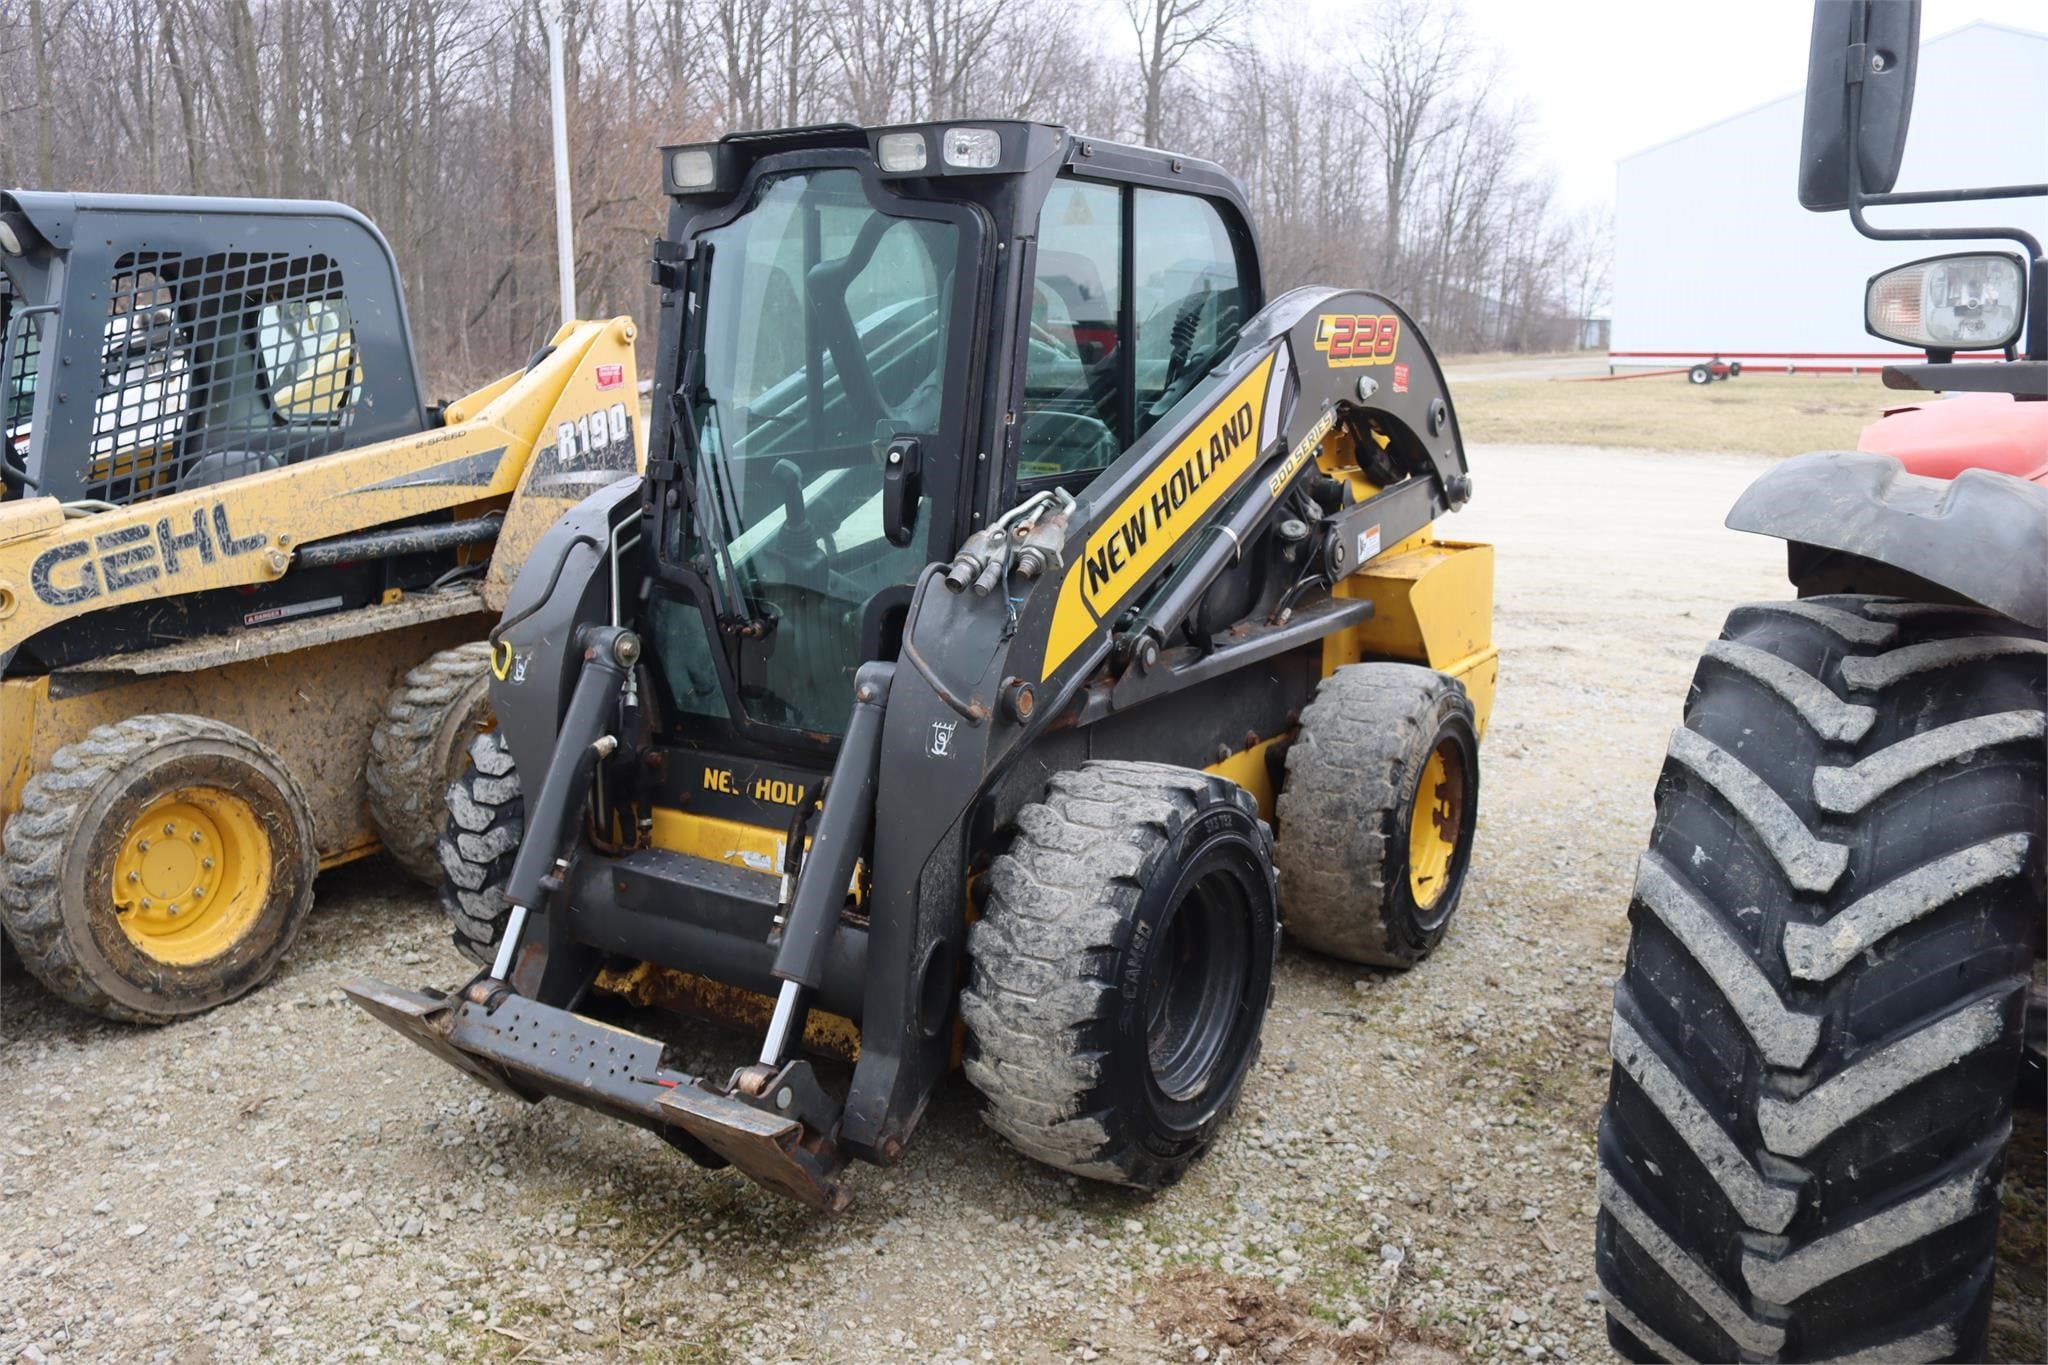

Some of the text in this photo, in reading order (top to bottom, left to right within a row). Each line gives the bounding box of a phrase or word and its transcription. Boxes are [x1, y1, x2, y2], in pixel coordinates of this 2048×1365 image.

[1315, 315, 1399, 366] L228
[556, 402, 628, 465] R190
[1269, 414, 1332, 493] 200 SERIES
[1086, 401, 1254, 596] NEW HOLLAND
[29, 501, 267, 606] GEHL
[755, 778, 824, 811] HOLL
